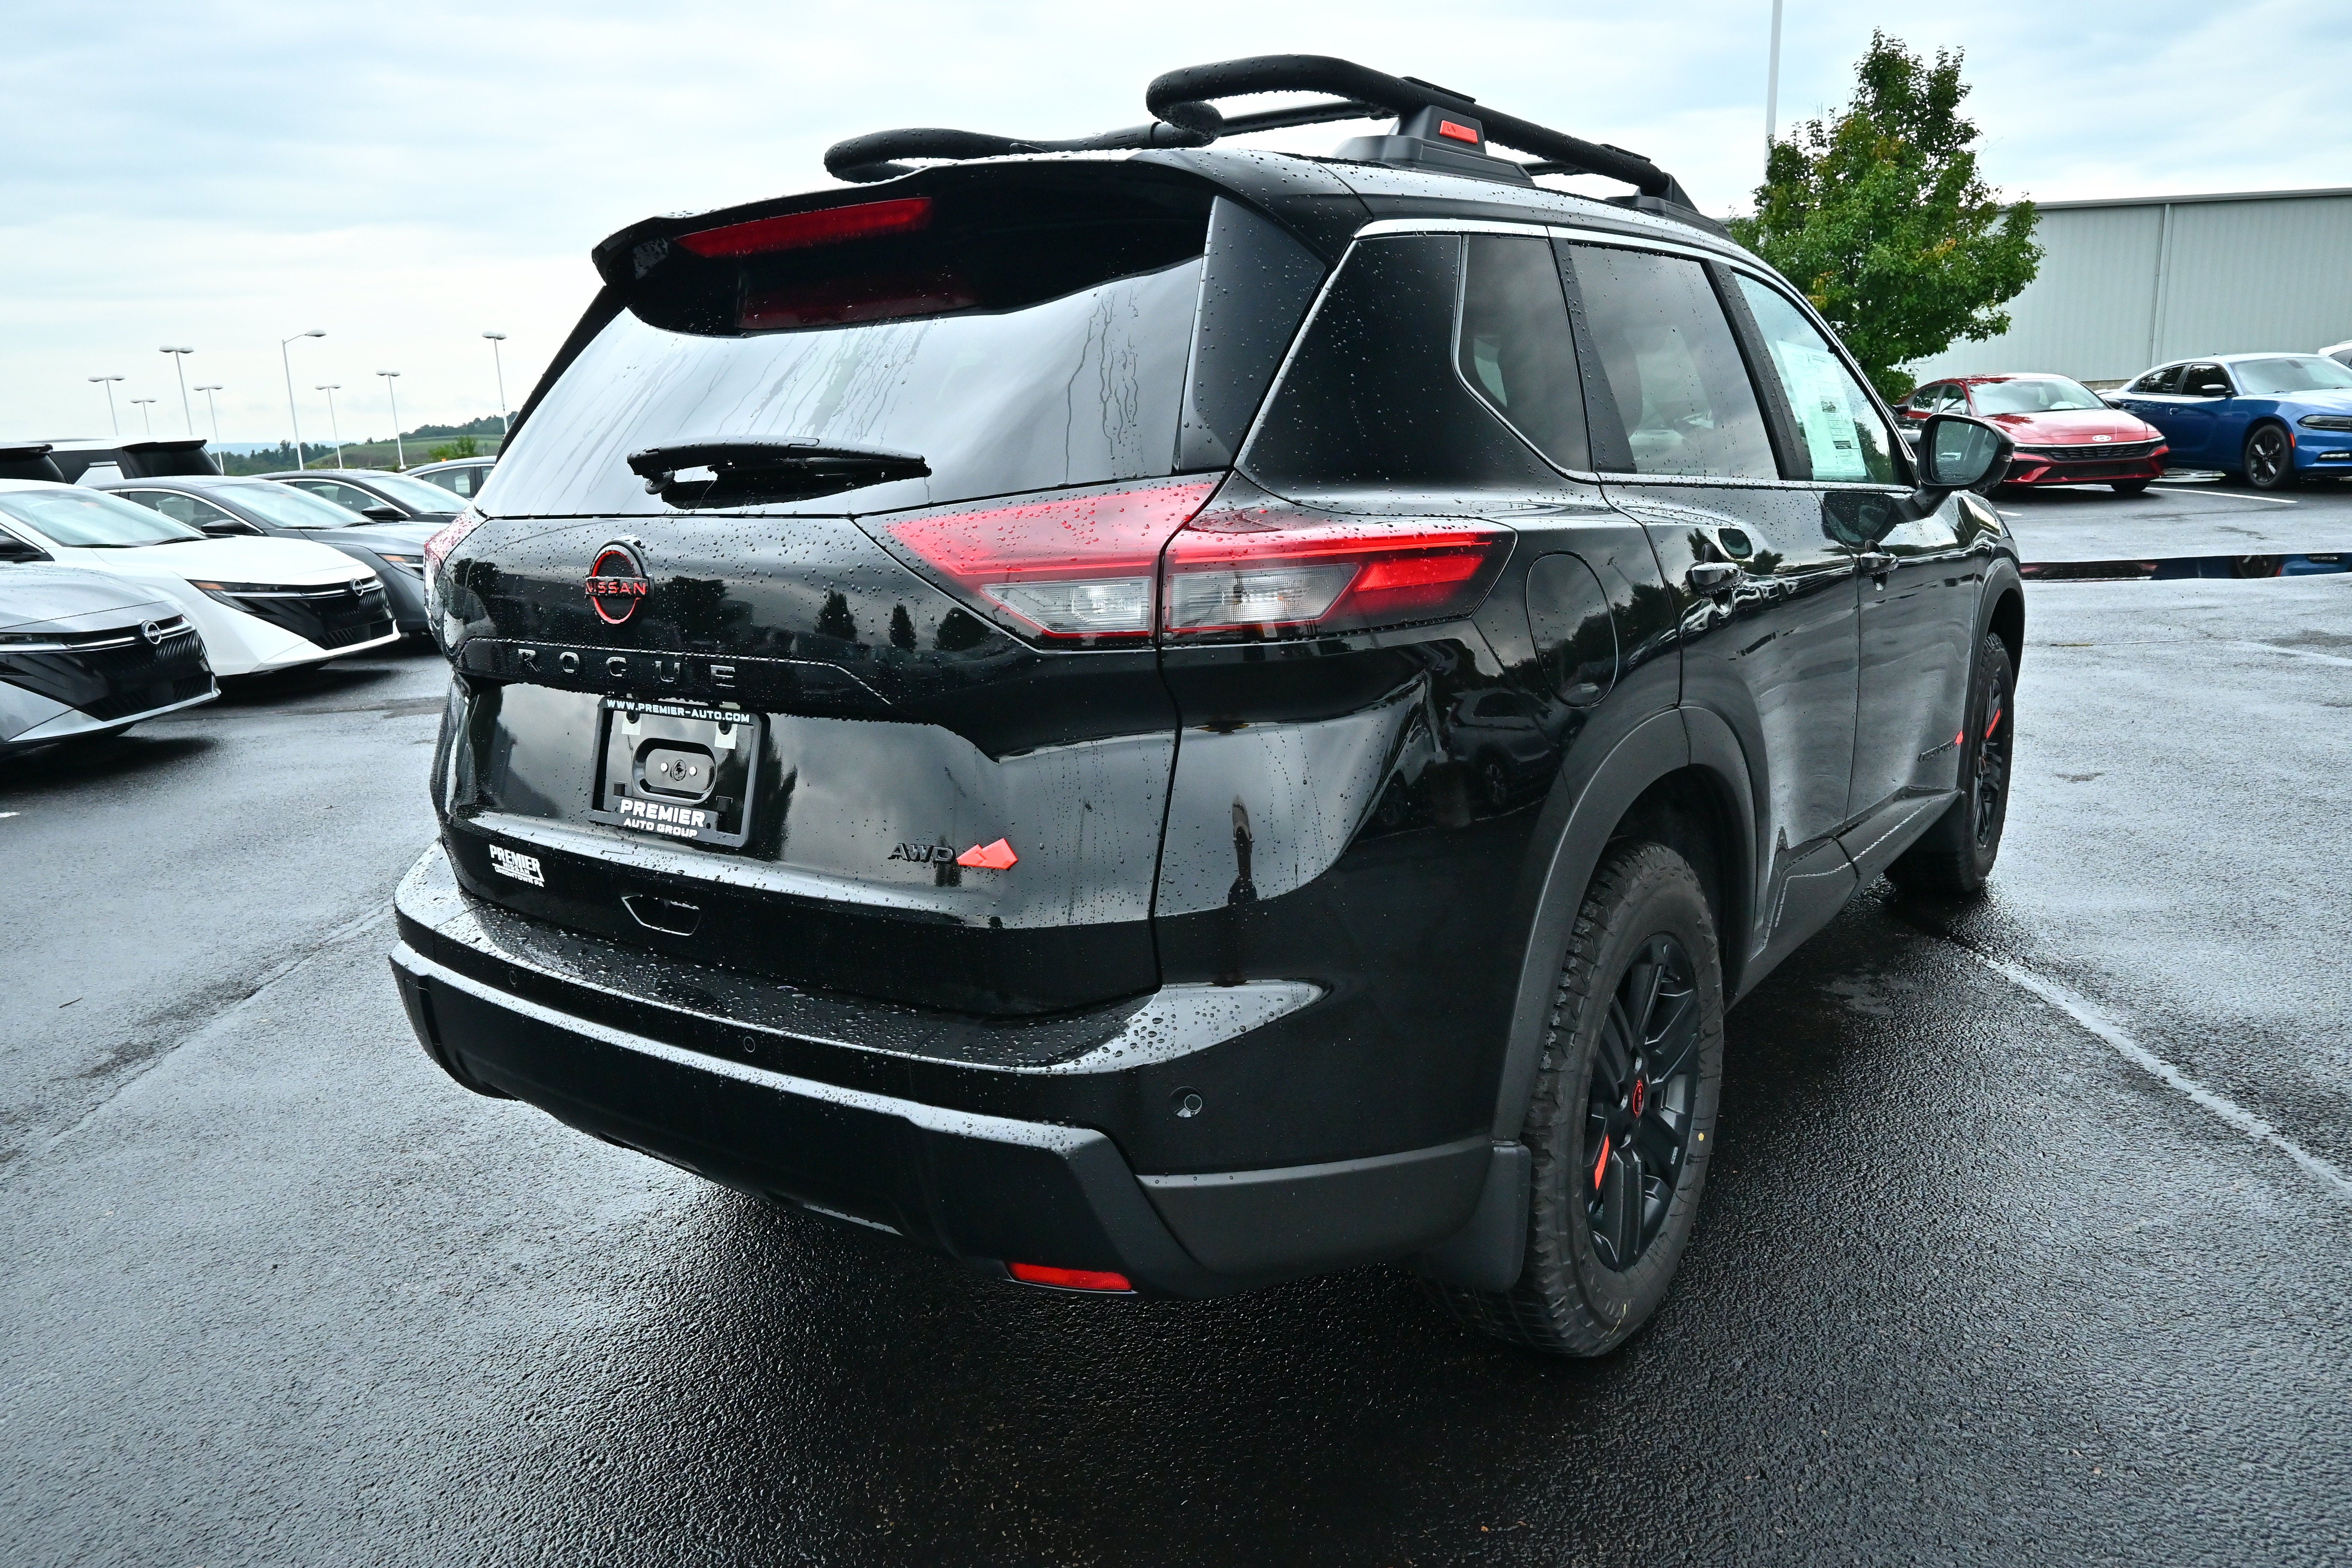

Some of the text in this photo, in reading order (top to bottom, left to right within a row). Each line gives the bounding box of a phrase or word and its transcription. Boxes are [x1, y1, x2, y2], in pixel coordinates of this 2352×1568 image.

[585, 581, 646, 595] NISSAN
[518, 648, 736, 687] ROGUE
[607, 699, 750, 723] WWW.PREMIER-AUTO.COM
[620, 799, 705, 828] PREMIER
[623, 818, 698, 838] AUTO GROUP
[489, 844, 540, 872] PREMIER
[887, 843, 956, 863] AWD
[494, 866, 544, 887] UNIONTOWN PA
[503, 862, 530, 875] NISSAN
